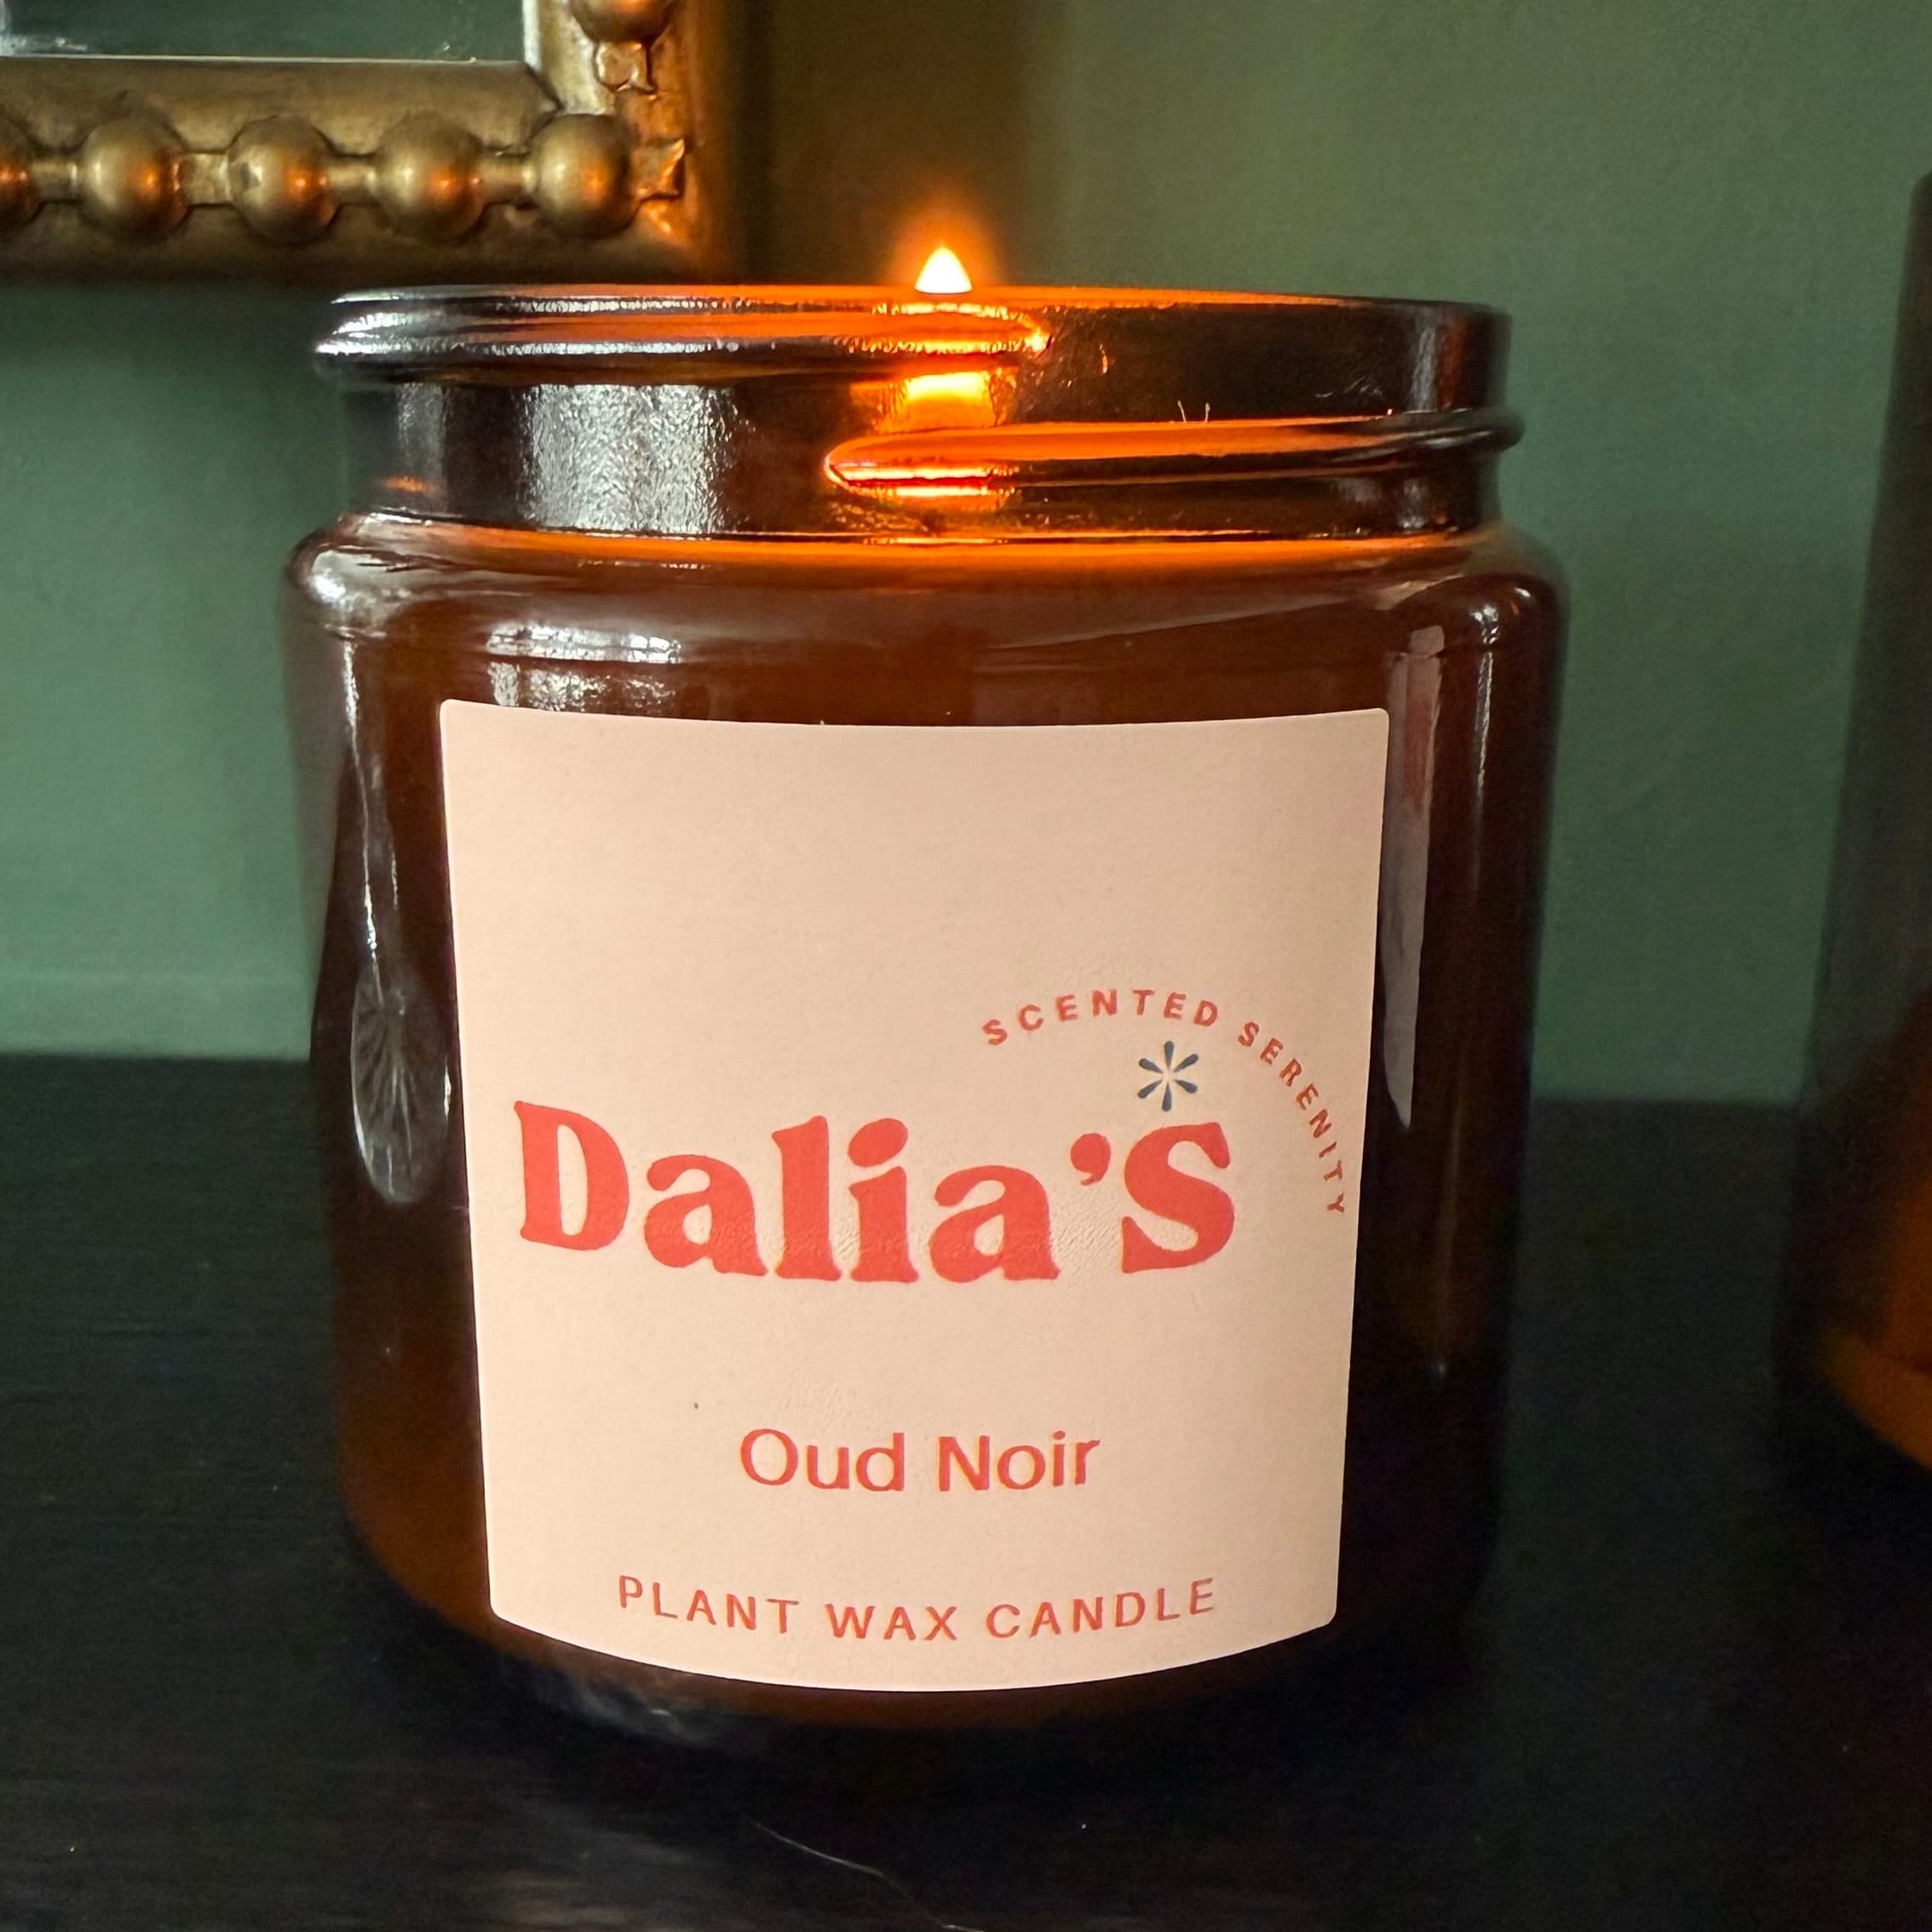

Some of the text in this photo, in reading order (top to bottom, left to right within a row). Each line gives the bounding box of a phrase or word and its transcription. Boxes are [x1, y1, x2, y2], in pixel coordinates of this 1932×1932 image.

[981, 988, 1346, 1215] SCENTED SERENITY
[740, 1428, 1101, 1492] Oud Noir
[618, 1574, 1216, 1642] PLANT WAX CANDLE
